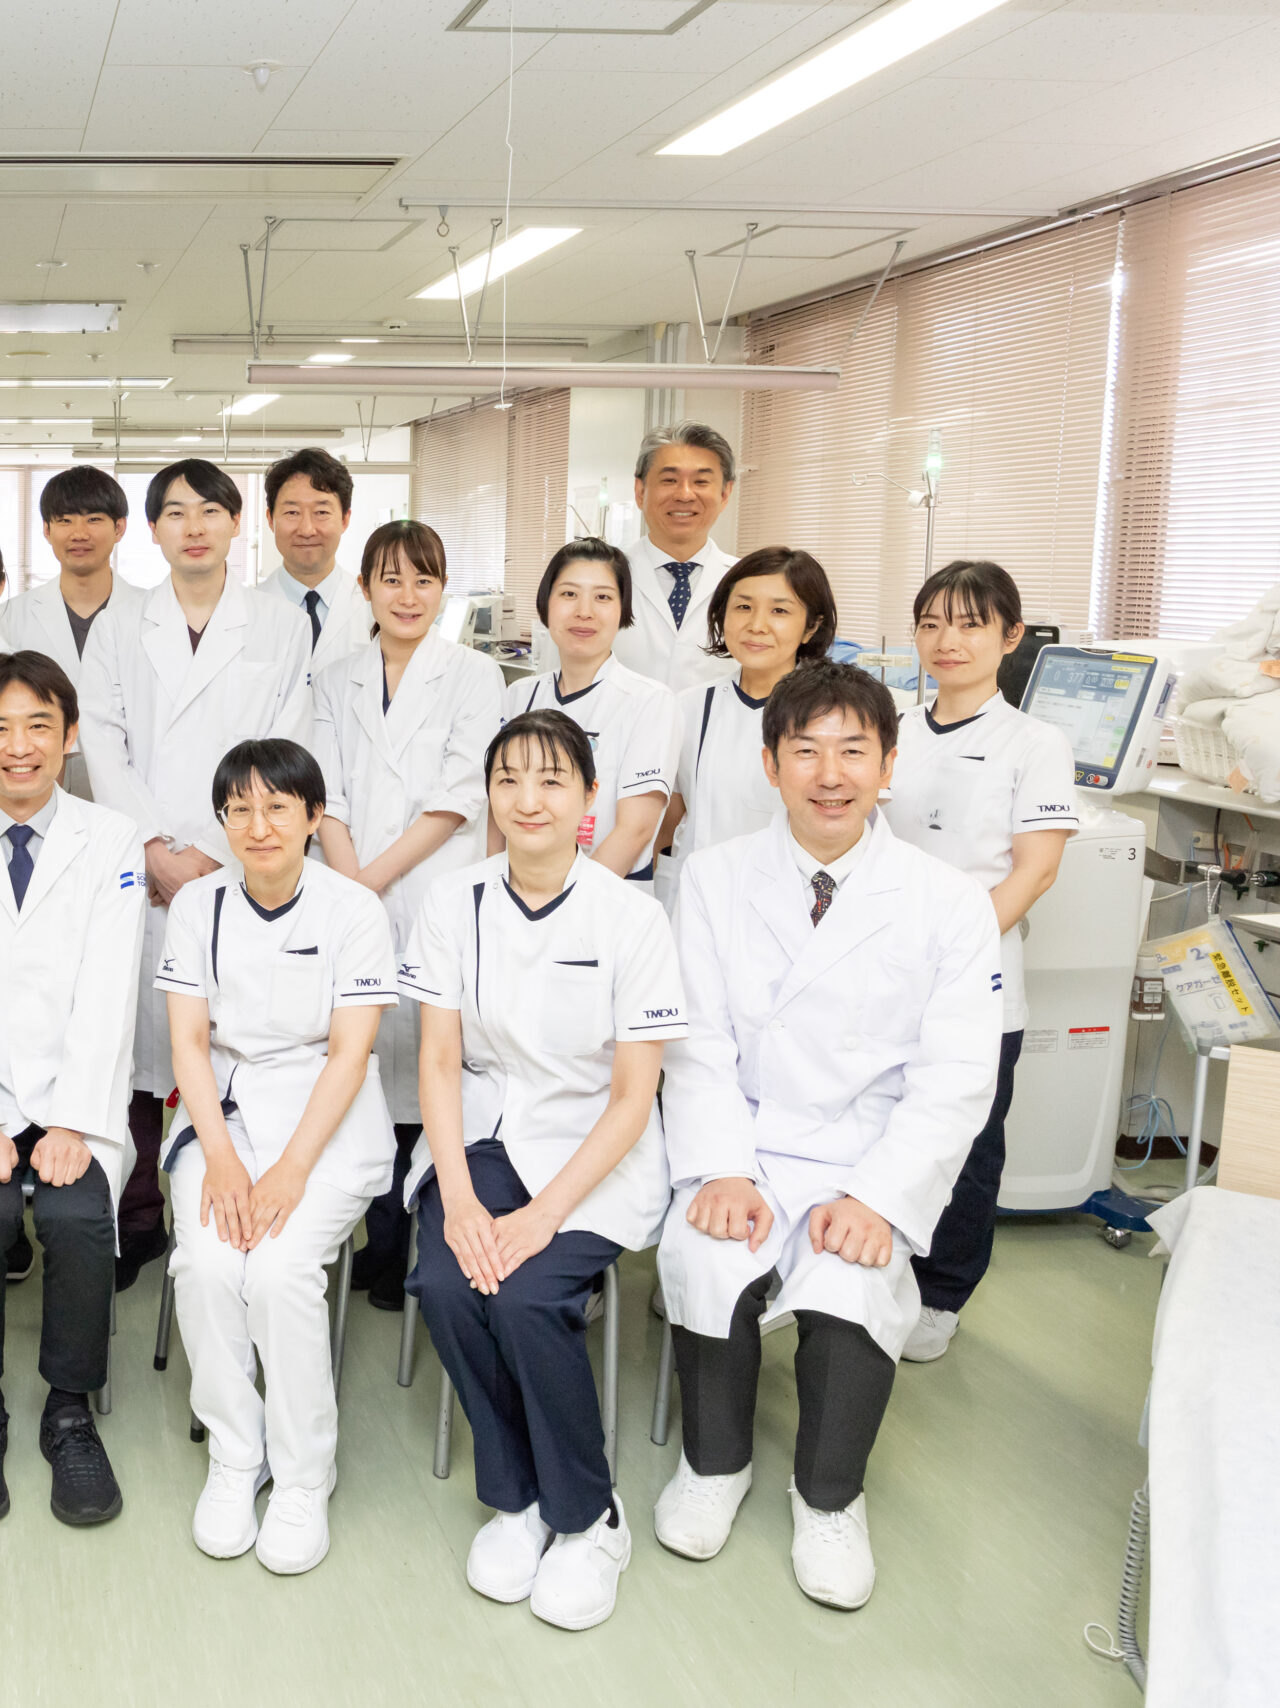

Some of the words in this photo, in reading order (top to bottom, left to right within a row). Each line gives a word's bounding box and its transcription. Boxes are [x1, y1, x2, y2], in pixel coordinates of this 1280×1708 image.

[1037, 804, 1070, 812] TMDU
[1127, 847, 1136, 861] 3
[353, 978, 381, 987] TMDU
[642, 1007, 679, 1019] TMDU
